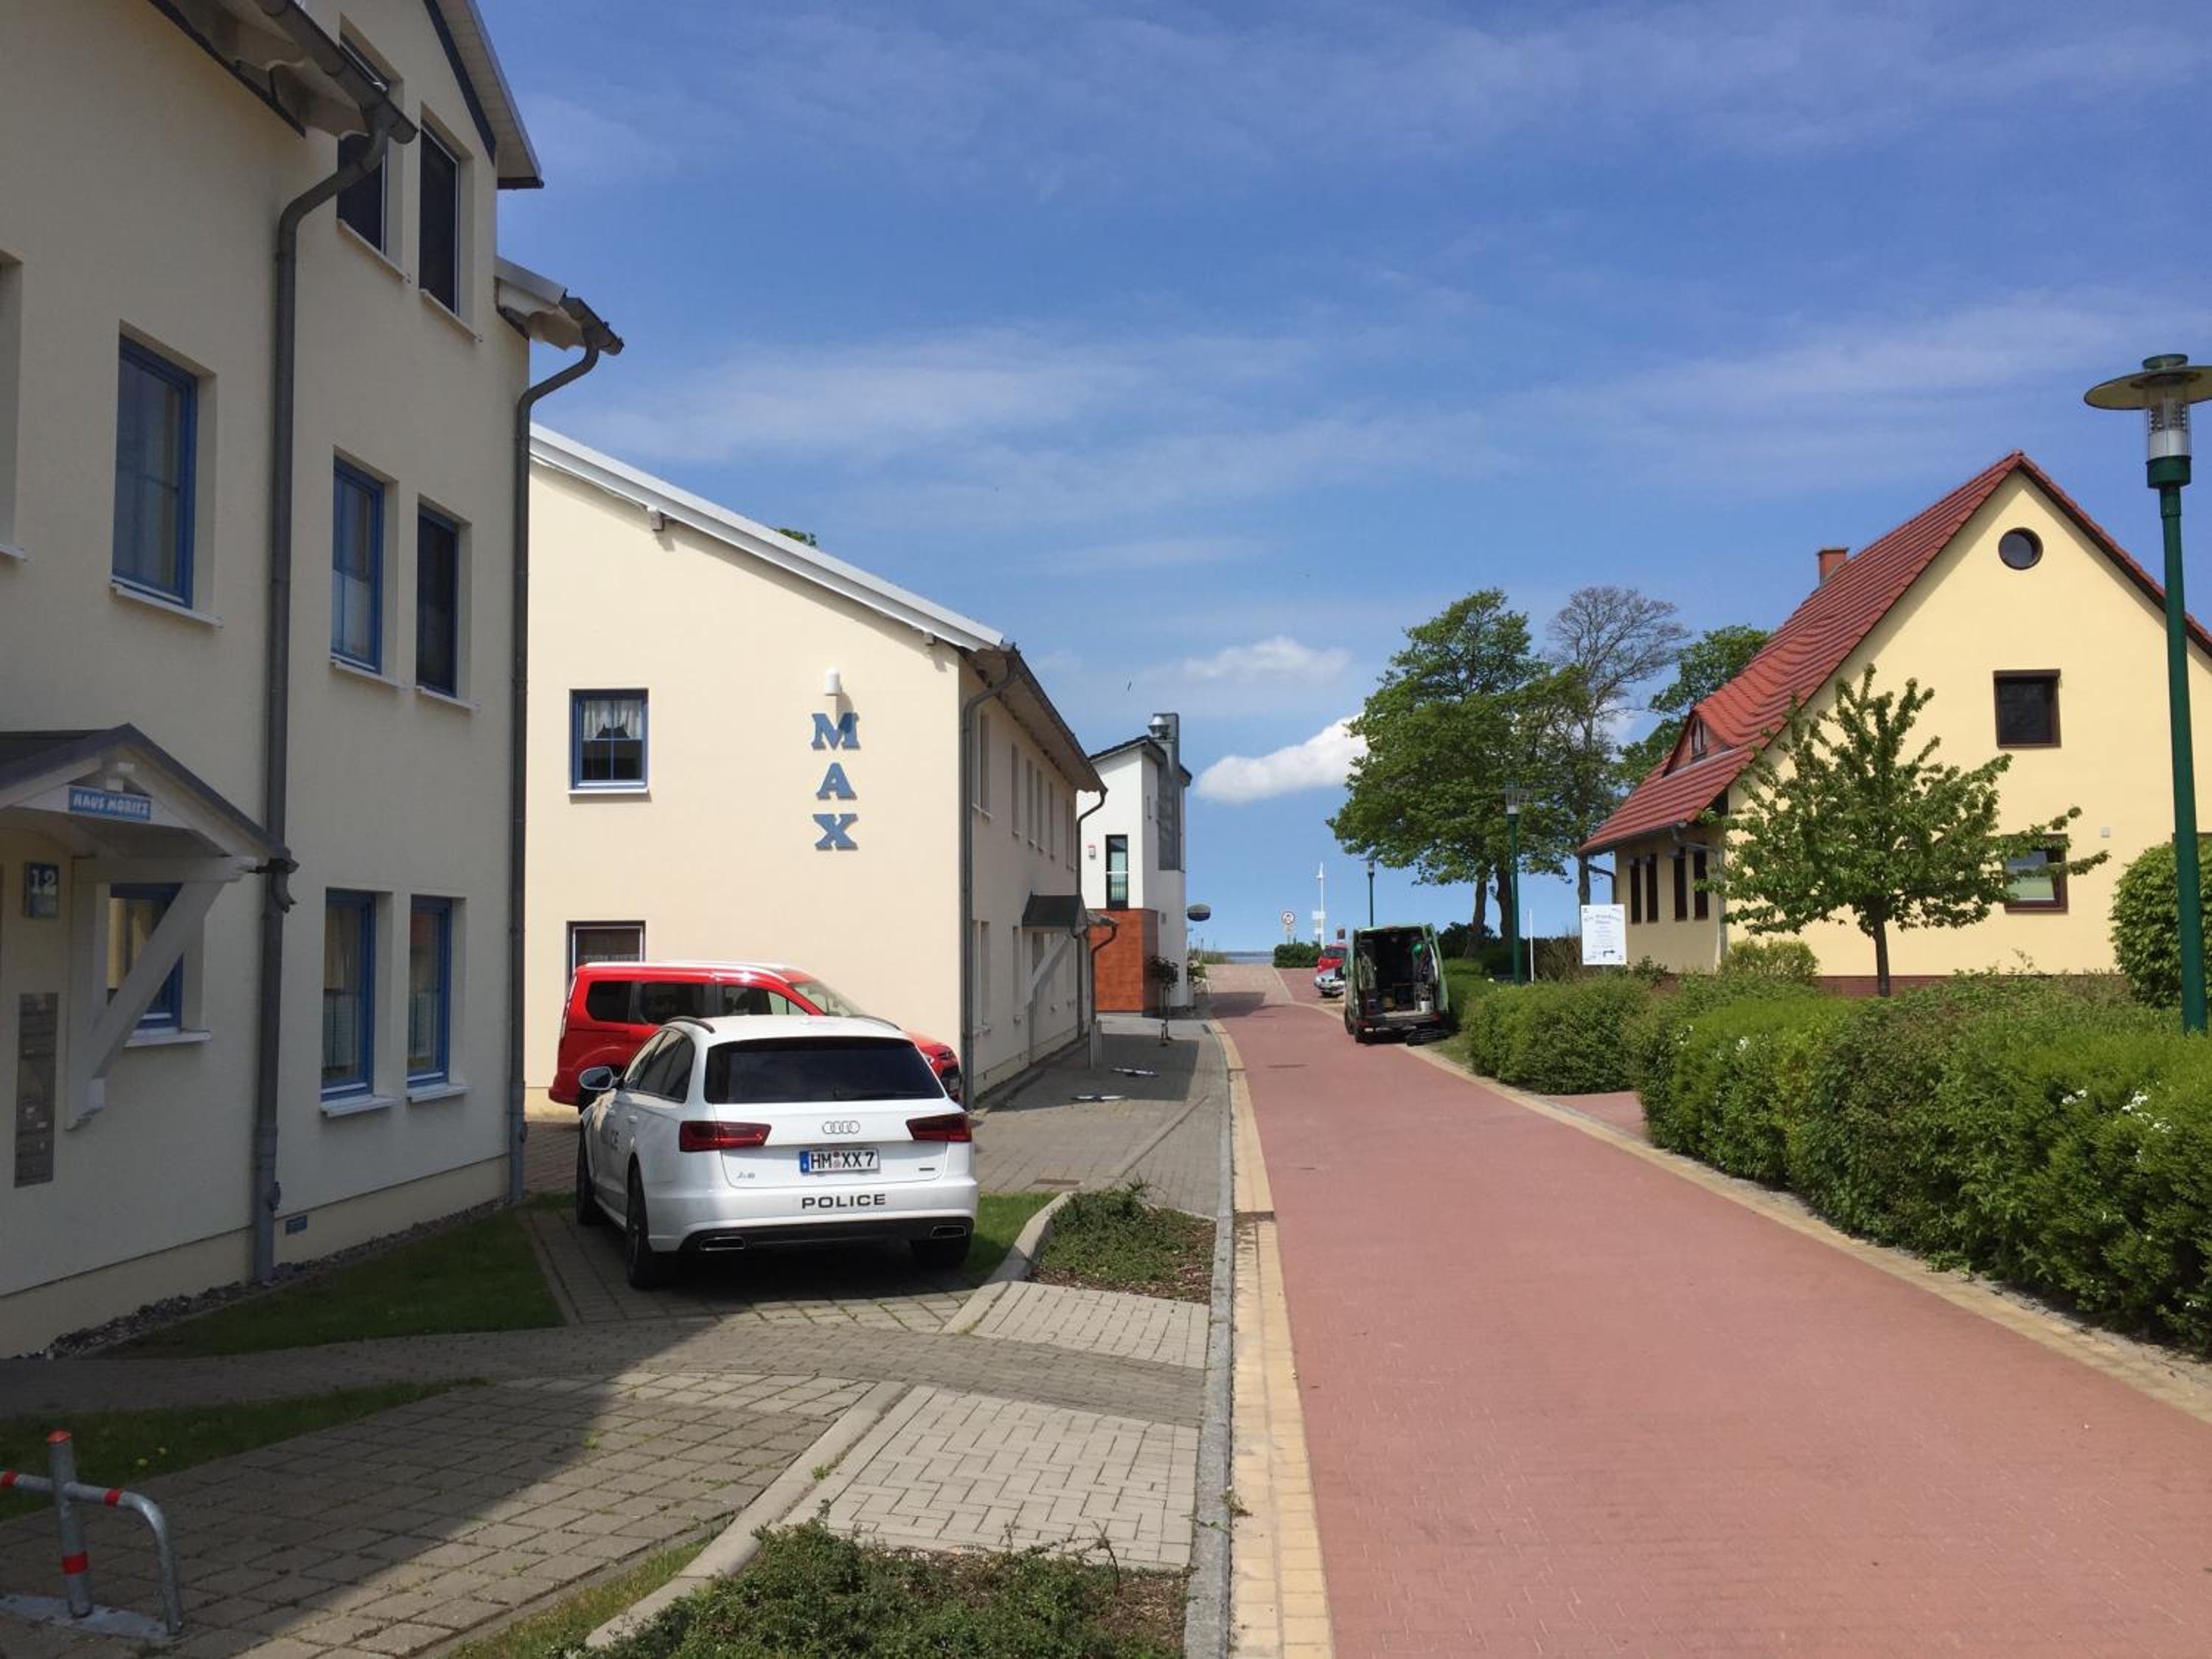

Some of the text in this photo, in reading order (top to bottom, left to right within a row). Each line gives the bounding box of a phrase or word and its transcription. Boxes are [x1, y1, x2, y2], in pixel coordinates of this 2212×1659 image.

[811, 712, 860, 851] MAX
[73, 793, 105, 811] HAUS
[32, 869, 57, 895] 12
[801, 1194, 886, 1208] POLICE
